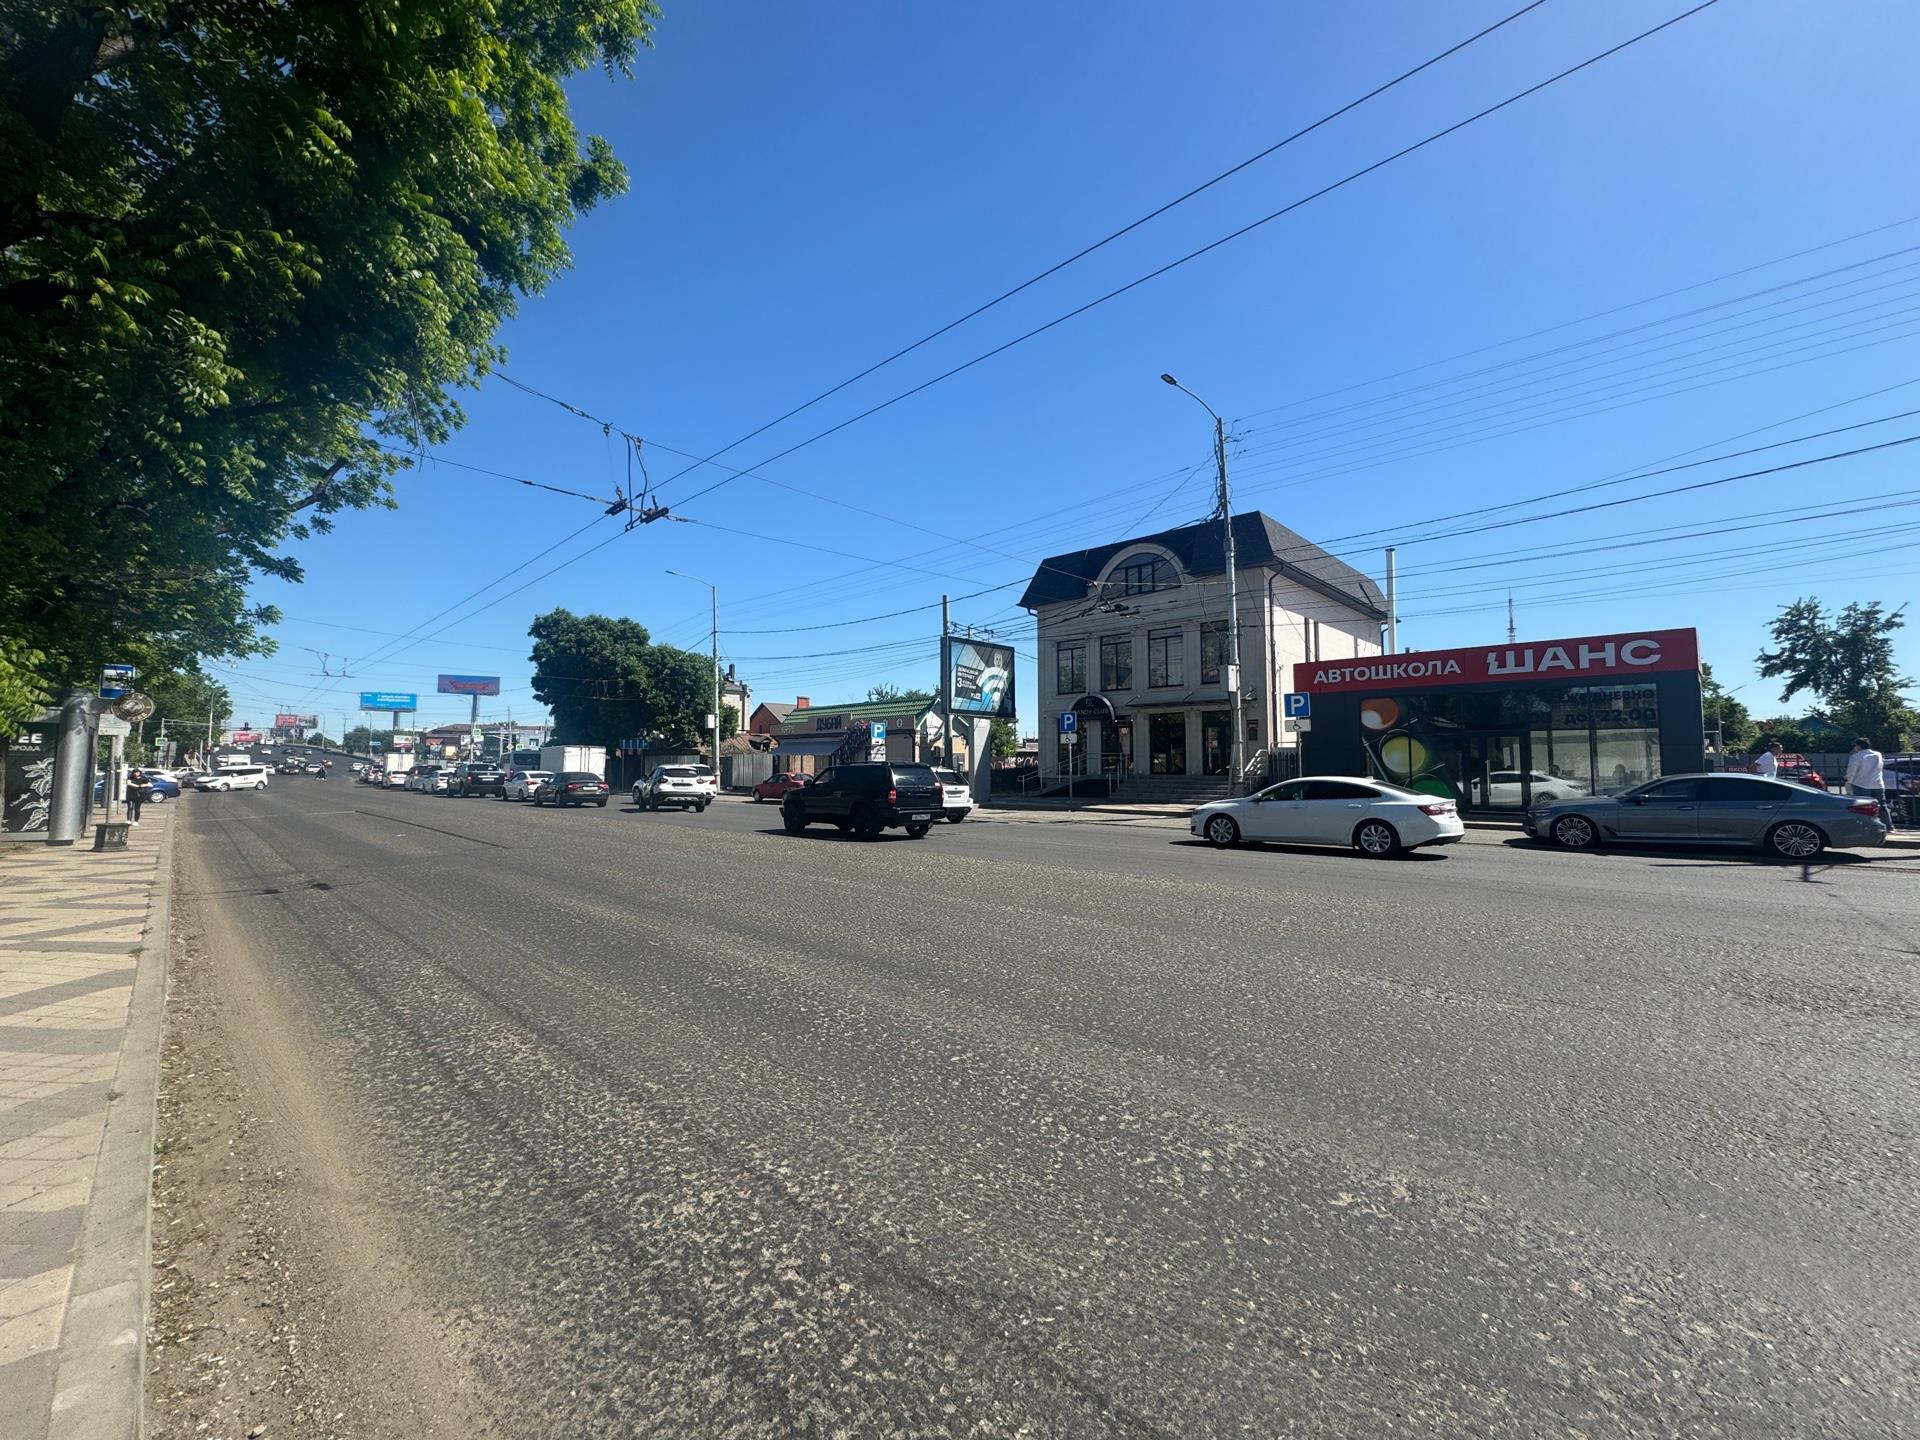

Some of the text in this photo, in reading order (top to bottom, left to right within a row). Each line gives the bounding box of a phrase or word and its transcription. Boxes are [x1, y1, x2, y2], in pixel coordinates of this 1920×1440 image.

[1313, 639, 1662, 684] АВТОШКОЛА ШАНС
[956, 677, 963, 688] 3
[816, 715, 842, 732] ДУБАЙ
